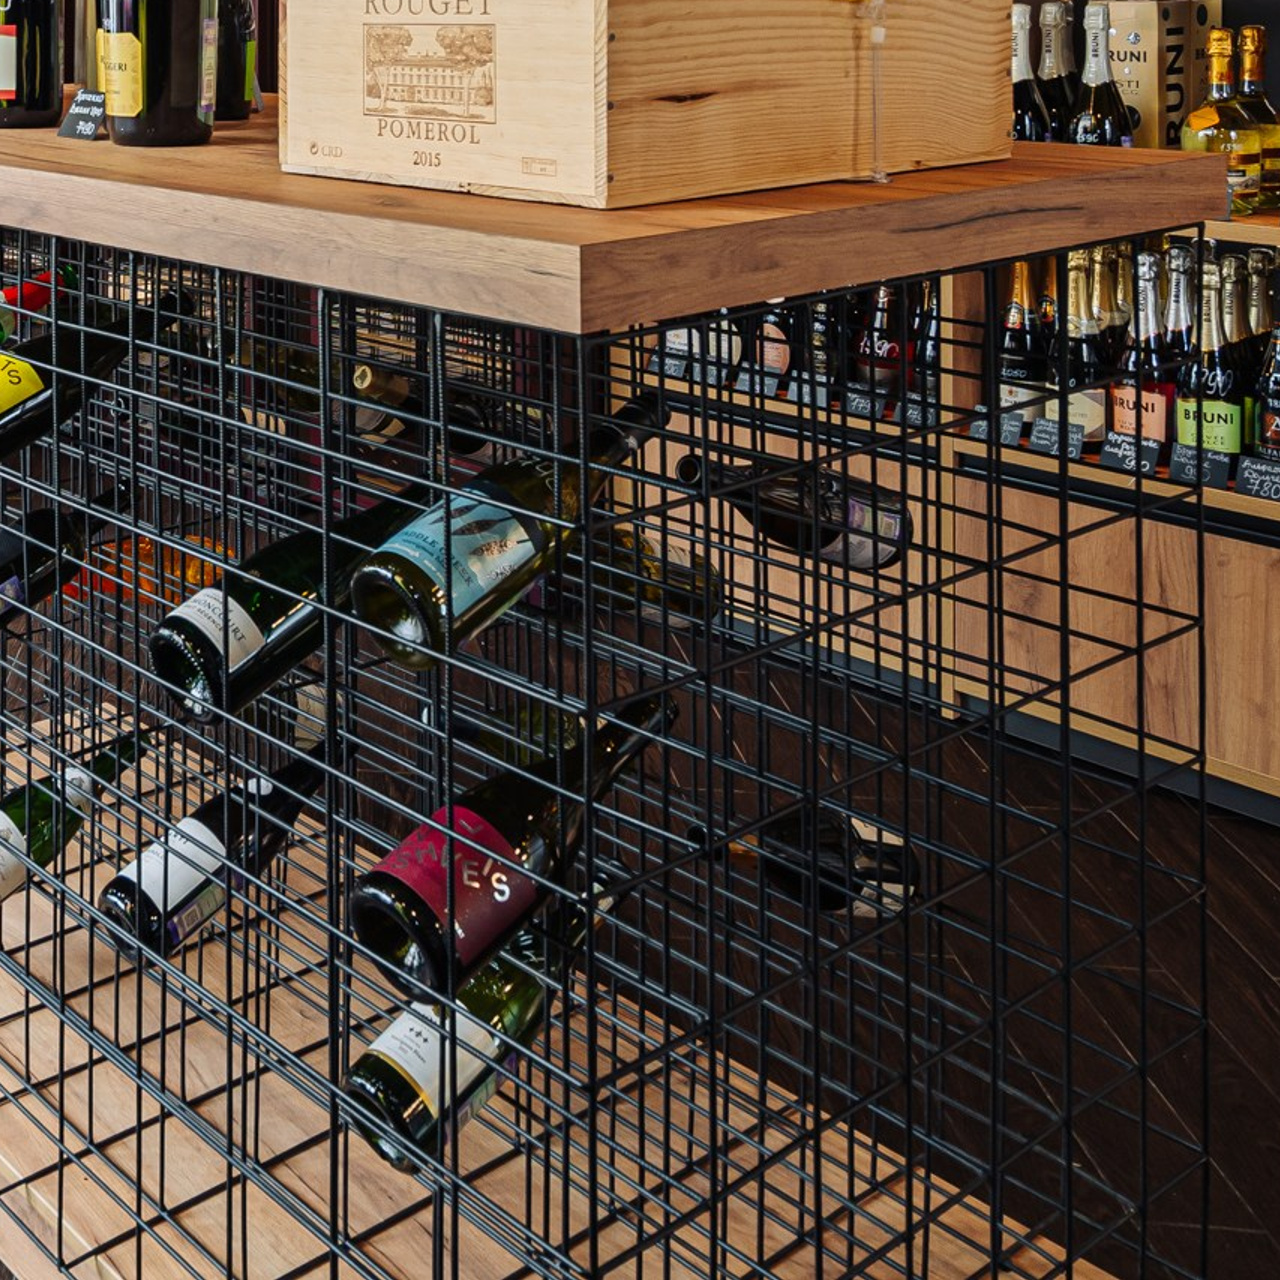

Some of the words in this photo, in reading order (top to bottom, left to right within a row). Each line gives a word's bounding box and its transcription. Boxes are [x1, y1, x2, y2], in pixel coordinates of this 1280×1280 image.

[1091, 31, 1099, 58] BRUNI
[1109, 50, 1147, 63] RUNI
[1117, 80, 1140, 89] STI
[1166, 26, 1184, 147] RUNI
[377, 118, 481, 145] POMEROL
[412, 150, 442, 168] 2015
[1173, 277, 1181, 304] BRUNI
[1226, 288, 1234, 316] BRUNI
[1204, 295, 1212, 322] BRUNI
